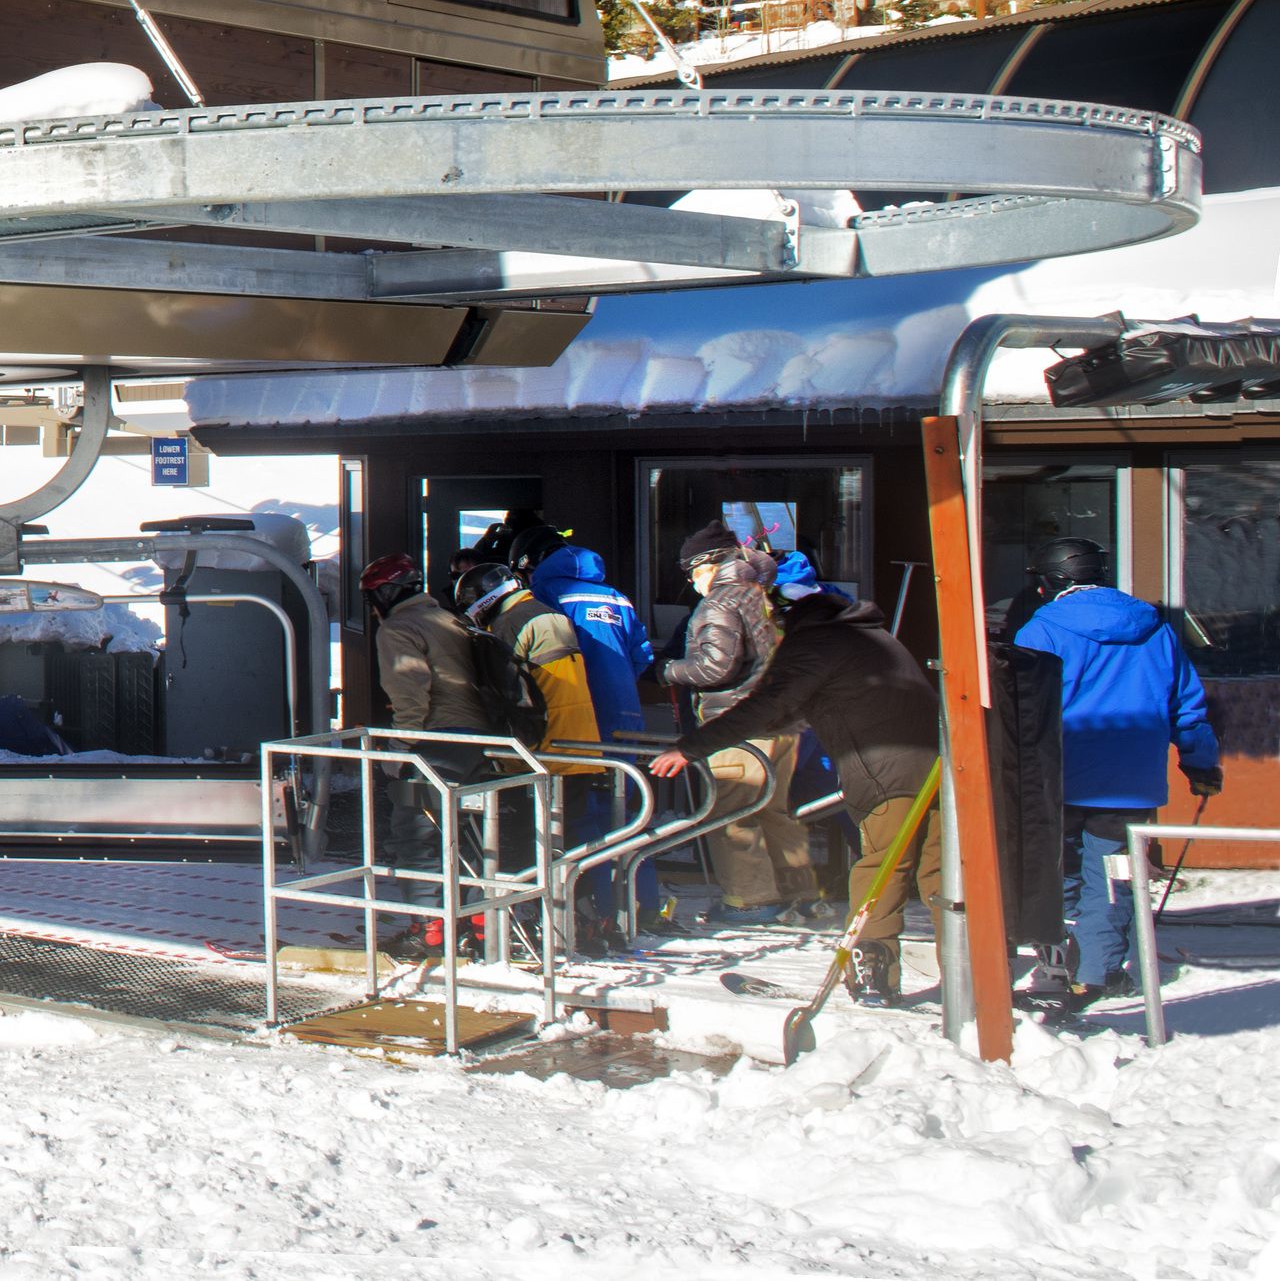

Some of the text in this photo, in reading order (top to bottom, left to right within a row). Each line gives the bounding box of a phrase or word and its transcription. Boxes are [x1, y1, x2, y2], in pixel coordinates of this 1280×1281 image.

[159, 445, 181, 454] LOWER
[155, 456, 185, 465] FOOTREST
[162, 467, 178, 476] HERE
